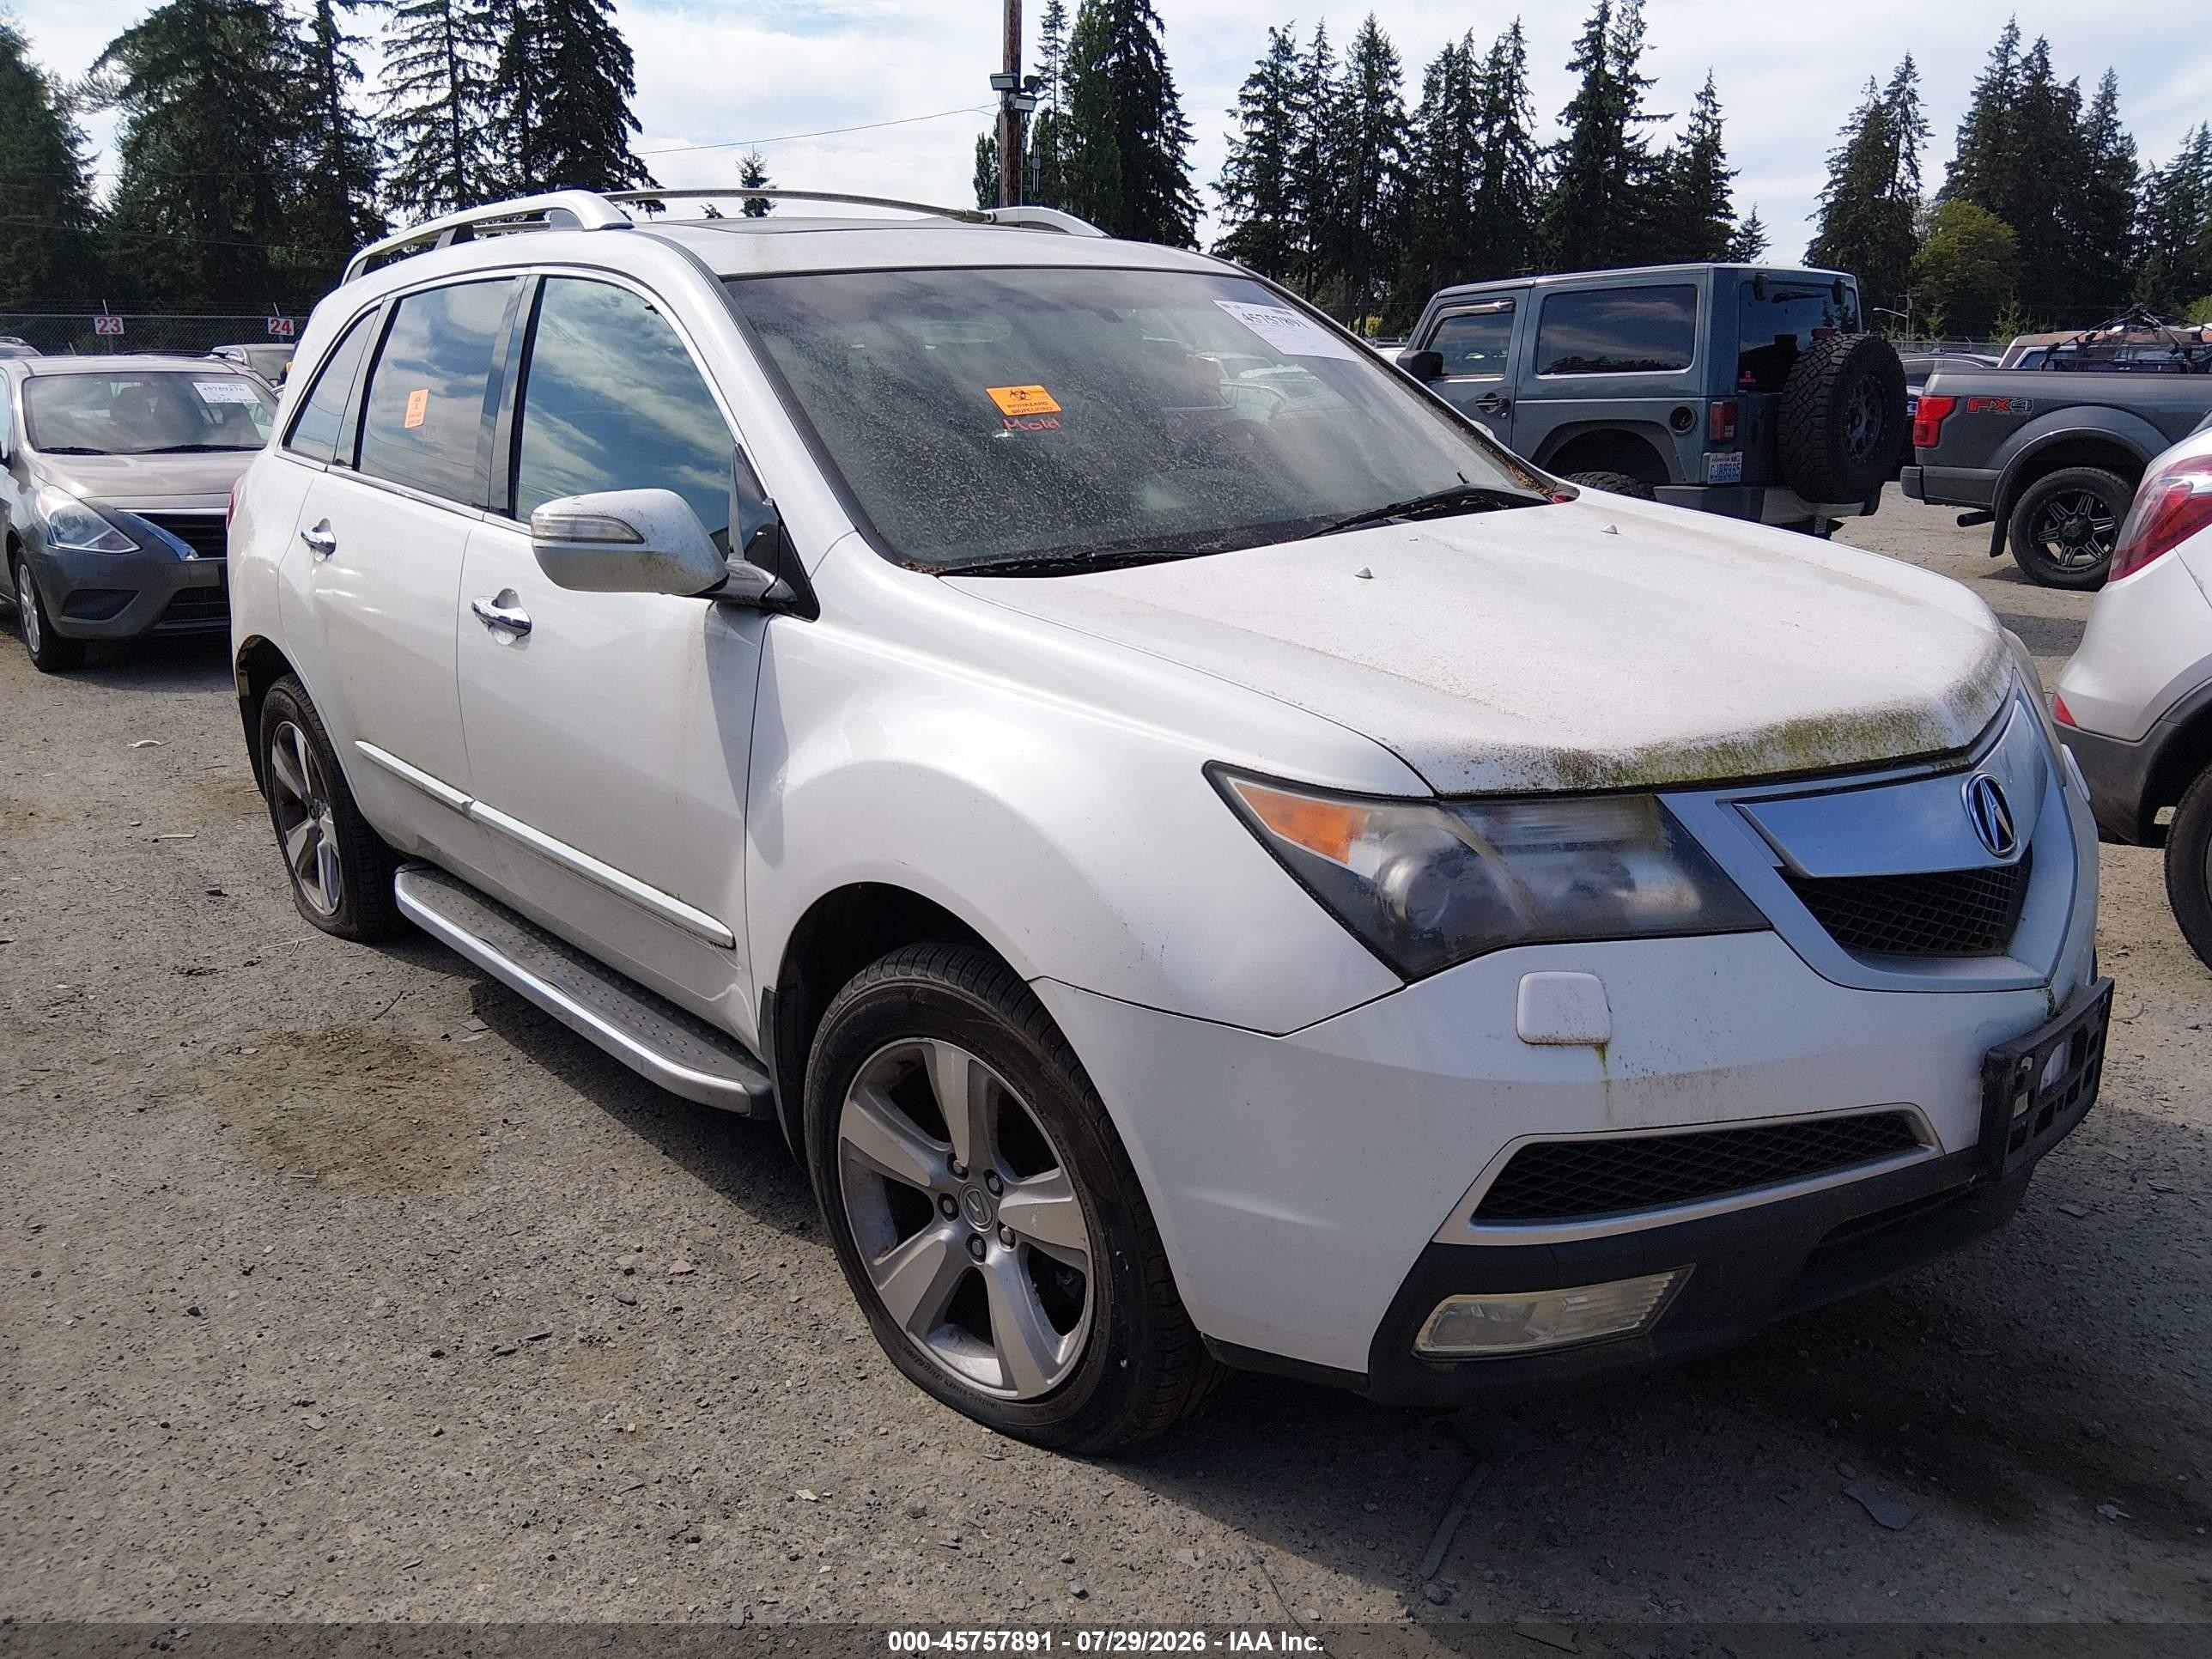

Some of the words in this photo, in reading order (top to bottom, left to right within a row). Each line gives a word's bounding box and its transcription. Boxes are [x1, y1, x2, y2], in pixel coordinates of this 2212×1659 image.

[98, 319, 121, 333] 23
[270, 319, 292, 335] 24
[1242, 313, 1310, 329] 45757891
[1967, 398, 2034, 413] FX4
[1003, 416, 1061, 431] Mold
